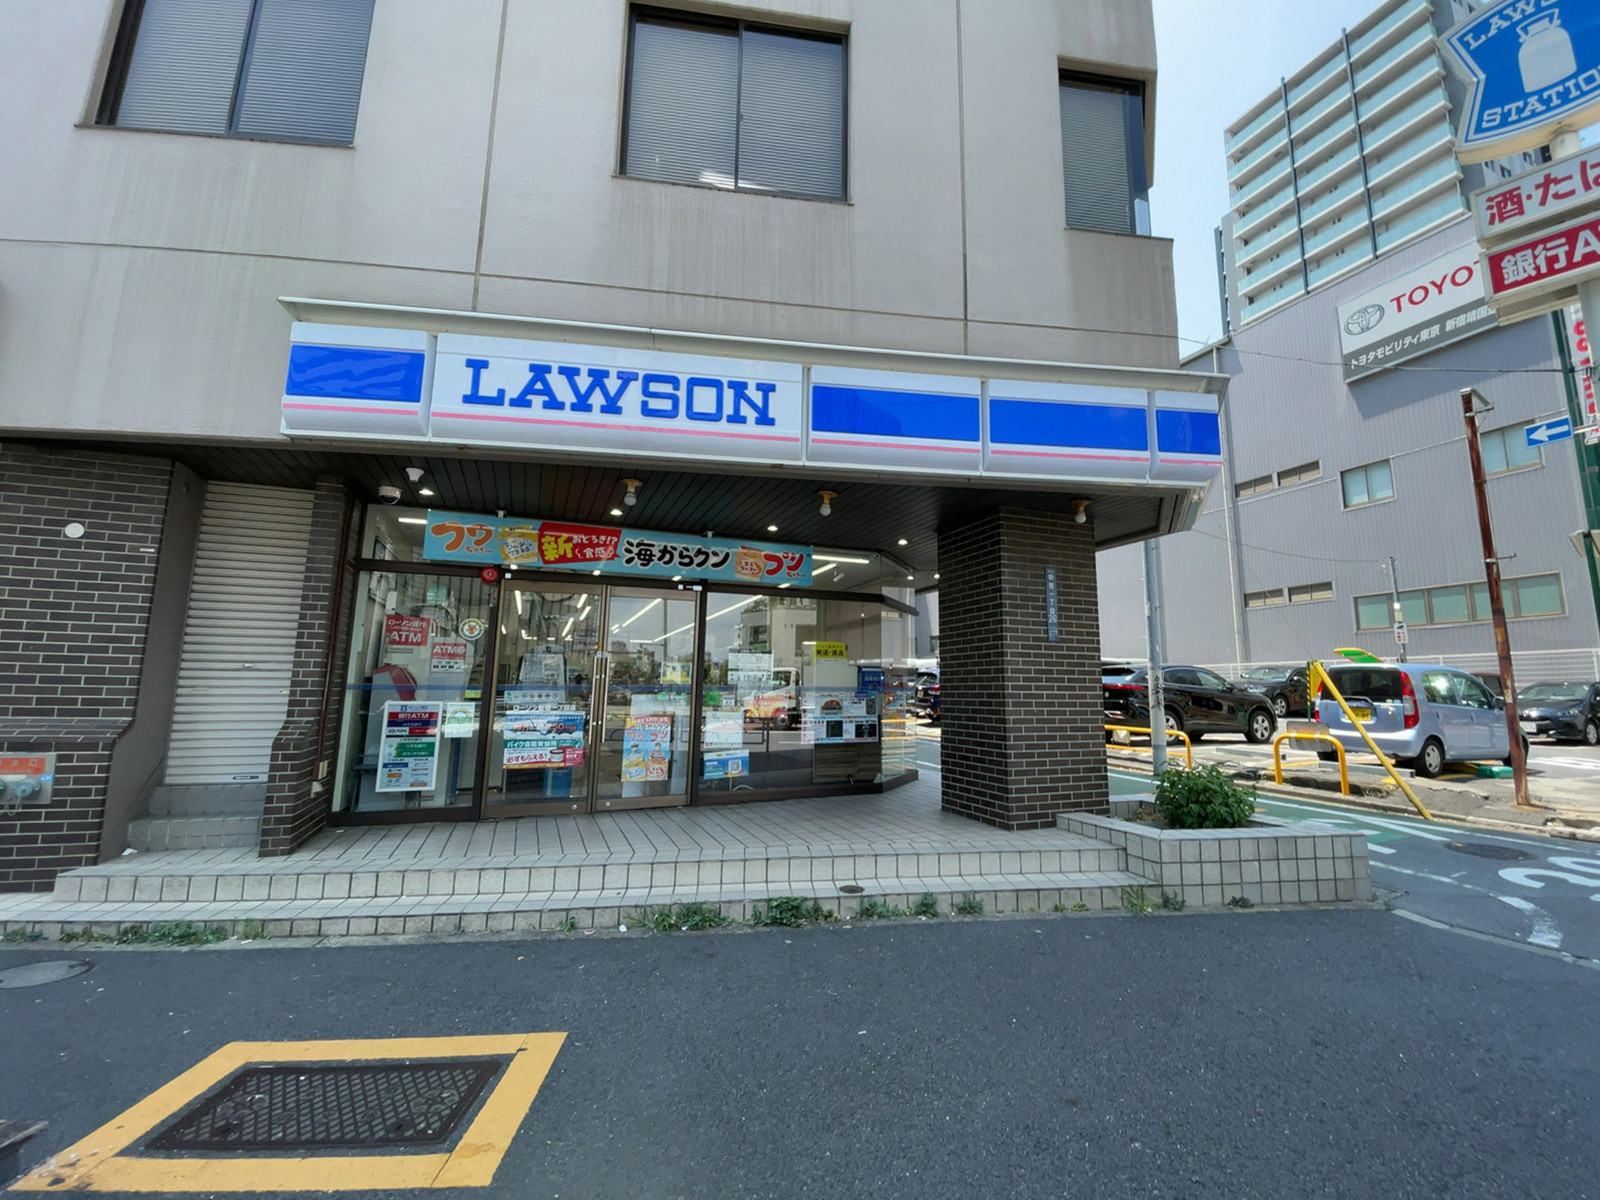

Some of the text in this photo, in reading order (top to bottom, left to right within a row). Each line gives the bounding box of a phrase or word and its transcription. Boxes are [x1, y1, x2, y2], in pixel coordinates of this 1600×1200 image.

[1463, 0, 1559, 50] LAW
[1481, 64, 1600, 129] STATIO
[1500, 223, 1600, 286] 銀行A
[1390, 259, 1480, 313] TOYO
[1351, 323, 1440, 370] トヨタモビリティ東京
[462, 358, 777, 427] LAWSON
[541, 534, 573, 561] 新
[623, 538, 731, 569] 海からクン
[391, 631, 422, 643] ATM
[433, 645, 457, 654] ATM
